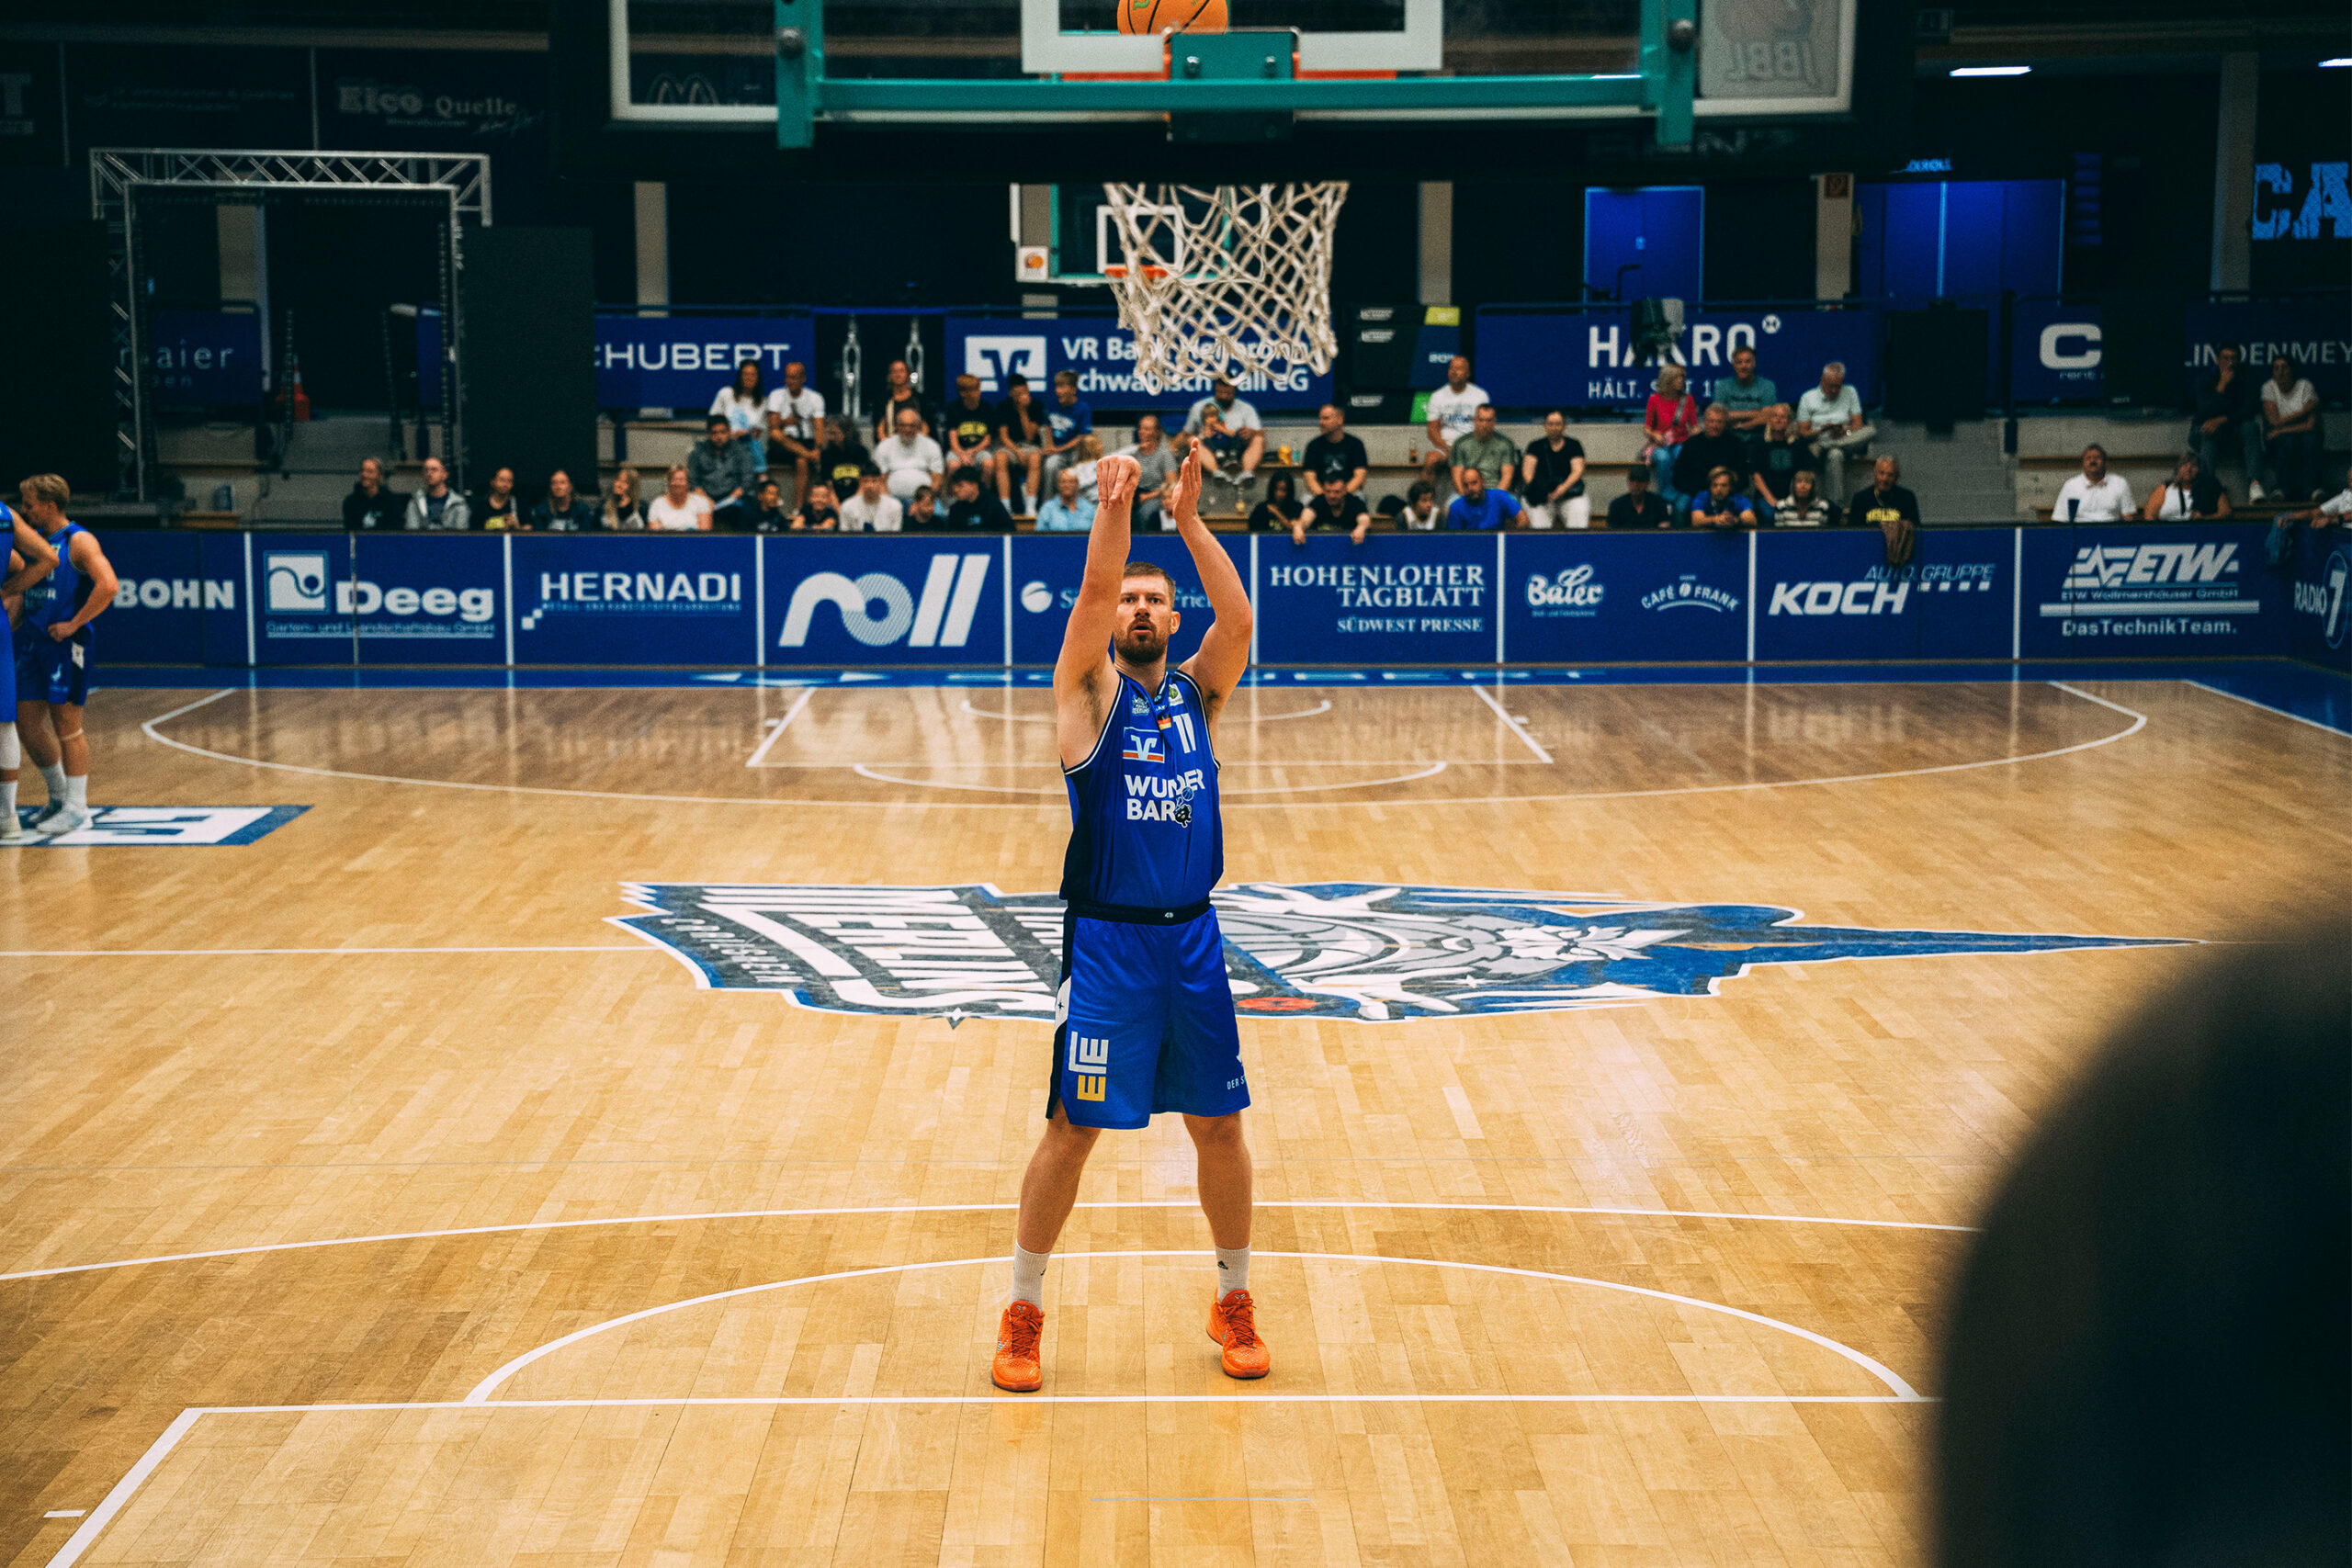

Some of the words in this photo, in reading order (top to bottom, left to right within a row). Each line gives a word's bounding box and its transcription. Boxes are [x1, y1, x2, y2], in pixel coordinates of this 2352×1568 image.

[1062, 337, 1099, 361] VR
[2184, 340, 2352, 367] INENMEY
[1218, 367, 1268, 391] all
[1270, 564, 1485, 587] HOHENLOHER
[1920, 563, 1997, 581] GRUPPE
[2124, 543, 2239, 583] ETW
[335, 581, 494, 622] Deeg
[541, 572, 741, 602] HERNADI
[778, 554, 990, 647] roll
[1336, 586, 1485, 607] TAGBLATT
[1641, 583, 1675, 609] CAFÉ
[1693, 583, 1741, 613] FRANK
[1768, 581, 1911, 616] KOCH
[2293, 581, 2328, 617] RADIO
[1336, 615, 1416, 633] SÜDWEST
[1420, 616, 1484, 633] PRESSE
[1172, 712, 1197, 754] 11
[1125, 769, 1205, 798] WUNDER
[1126, 797, 1177, 821] BAR
